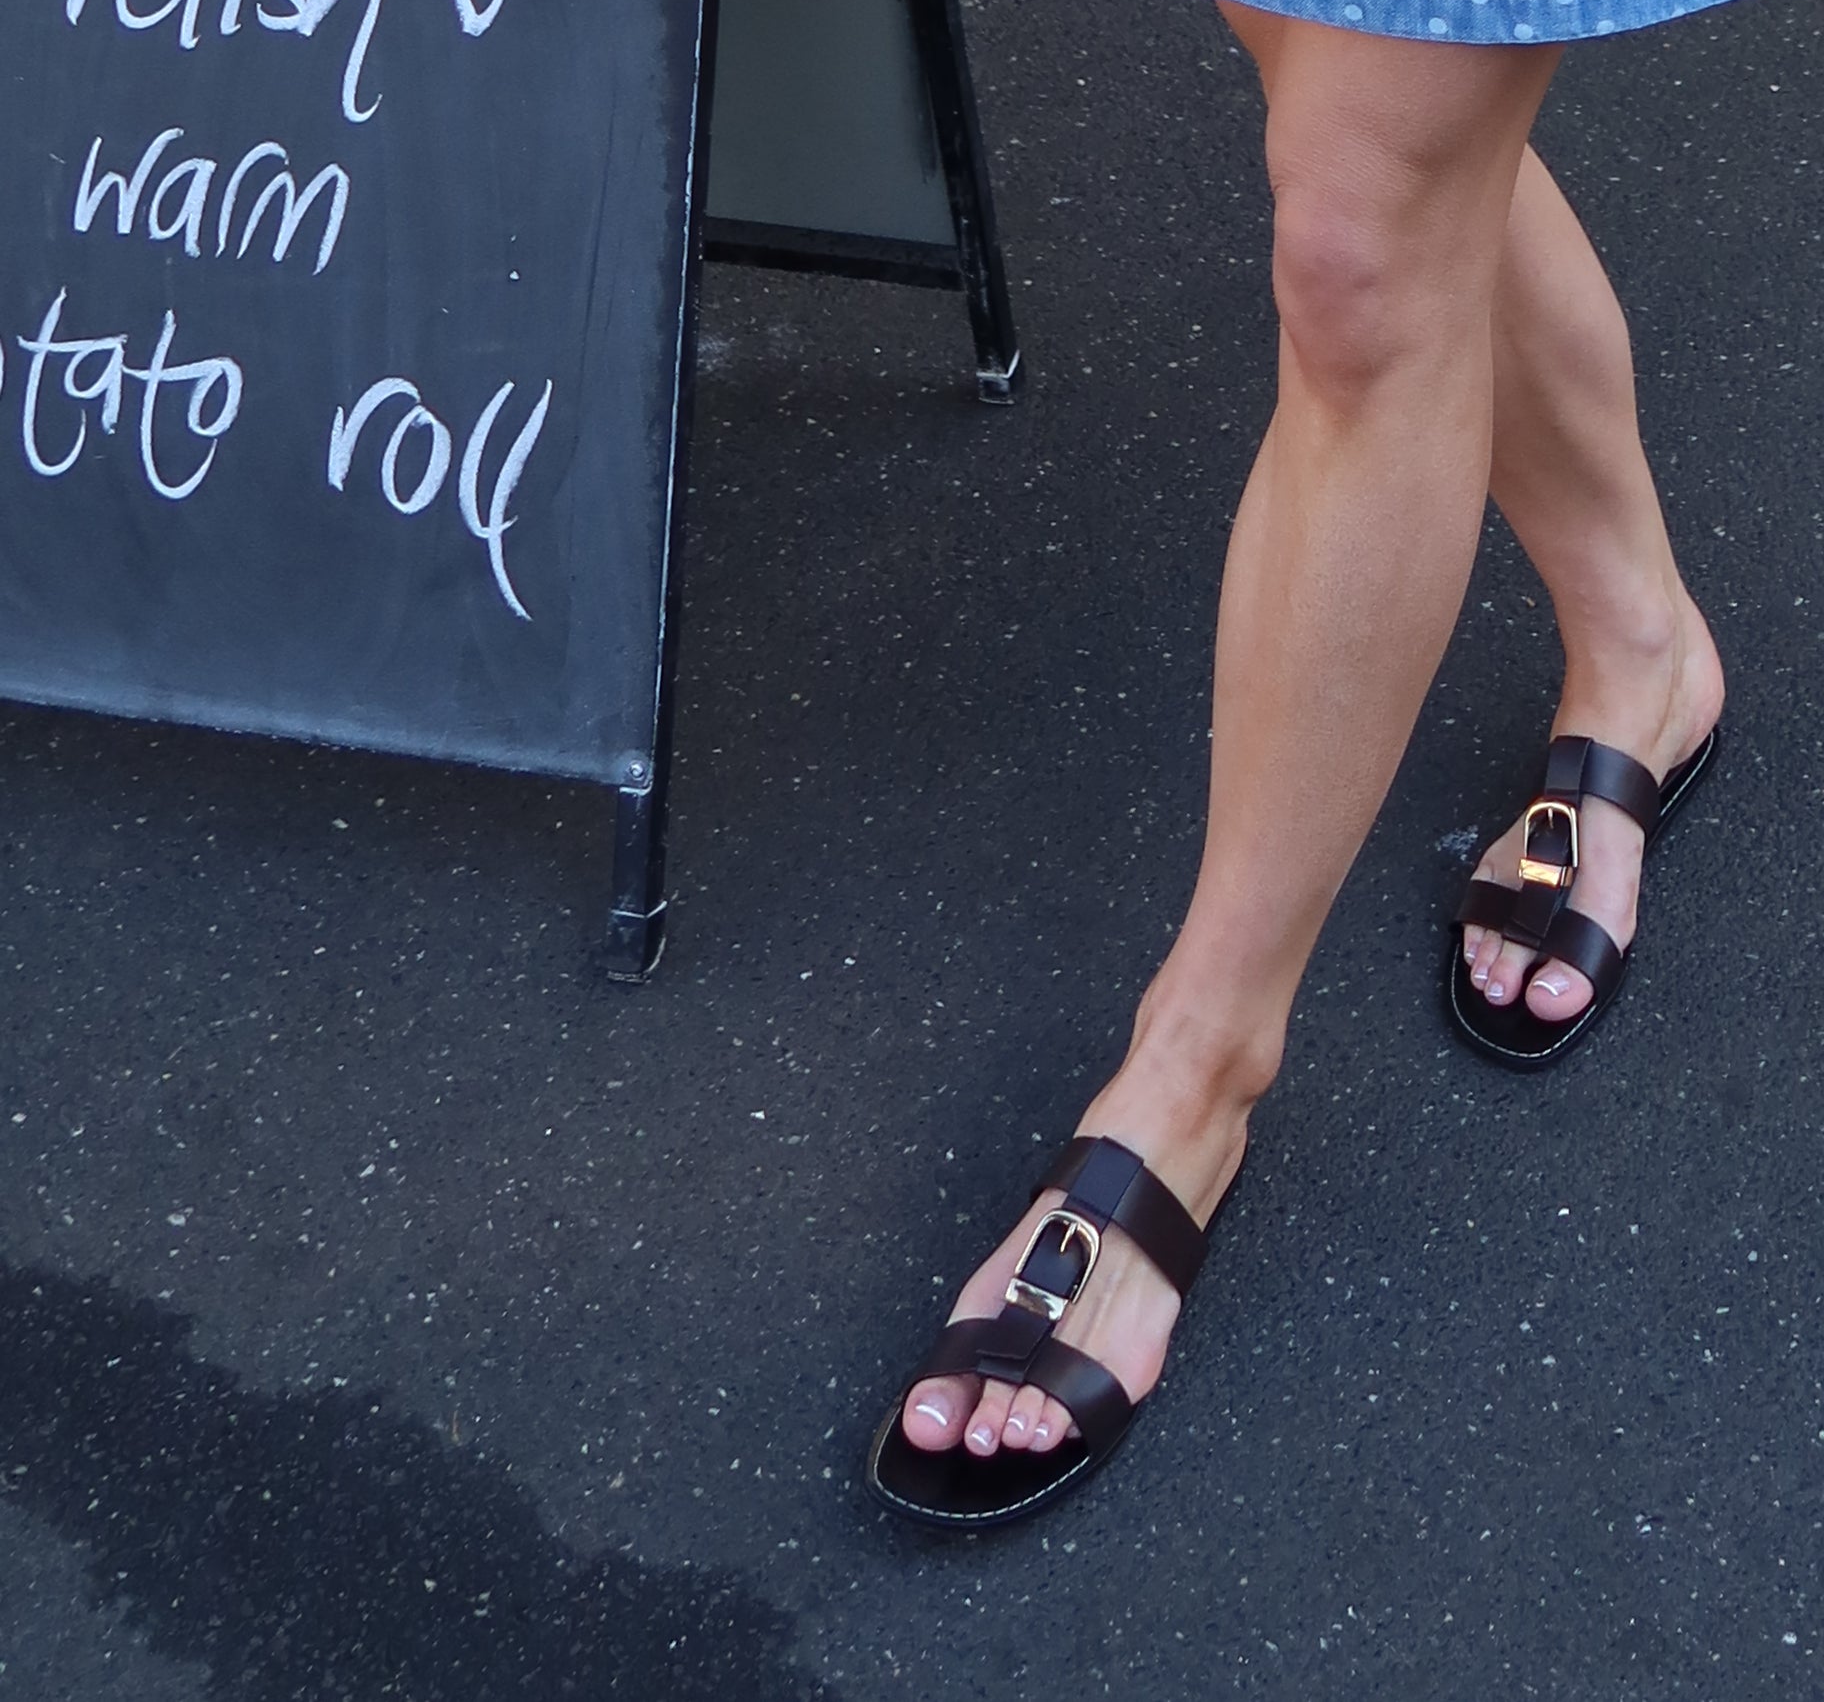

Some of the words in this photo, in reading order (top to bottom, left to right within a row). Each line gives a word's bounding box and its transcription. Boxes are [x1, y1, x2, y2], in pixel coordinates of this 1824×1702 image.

[73, 128, 351, 275] warm
[0, 286, 243, 500] tato
[328, 377, 552, 620] roll
